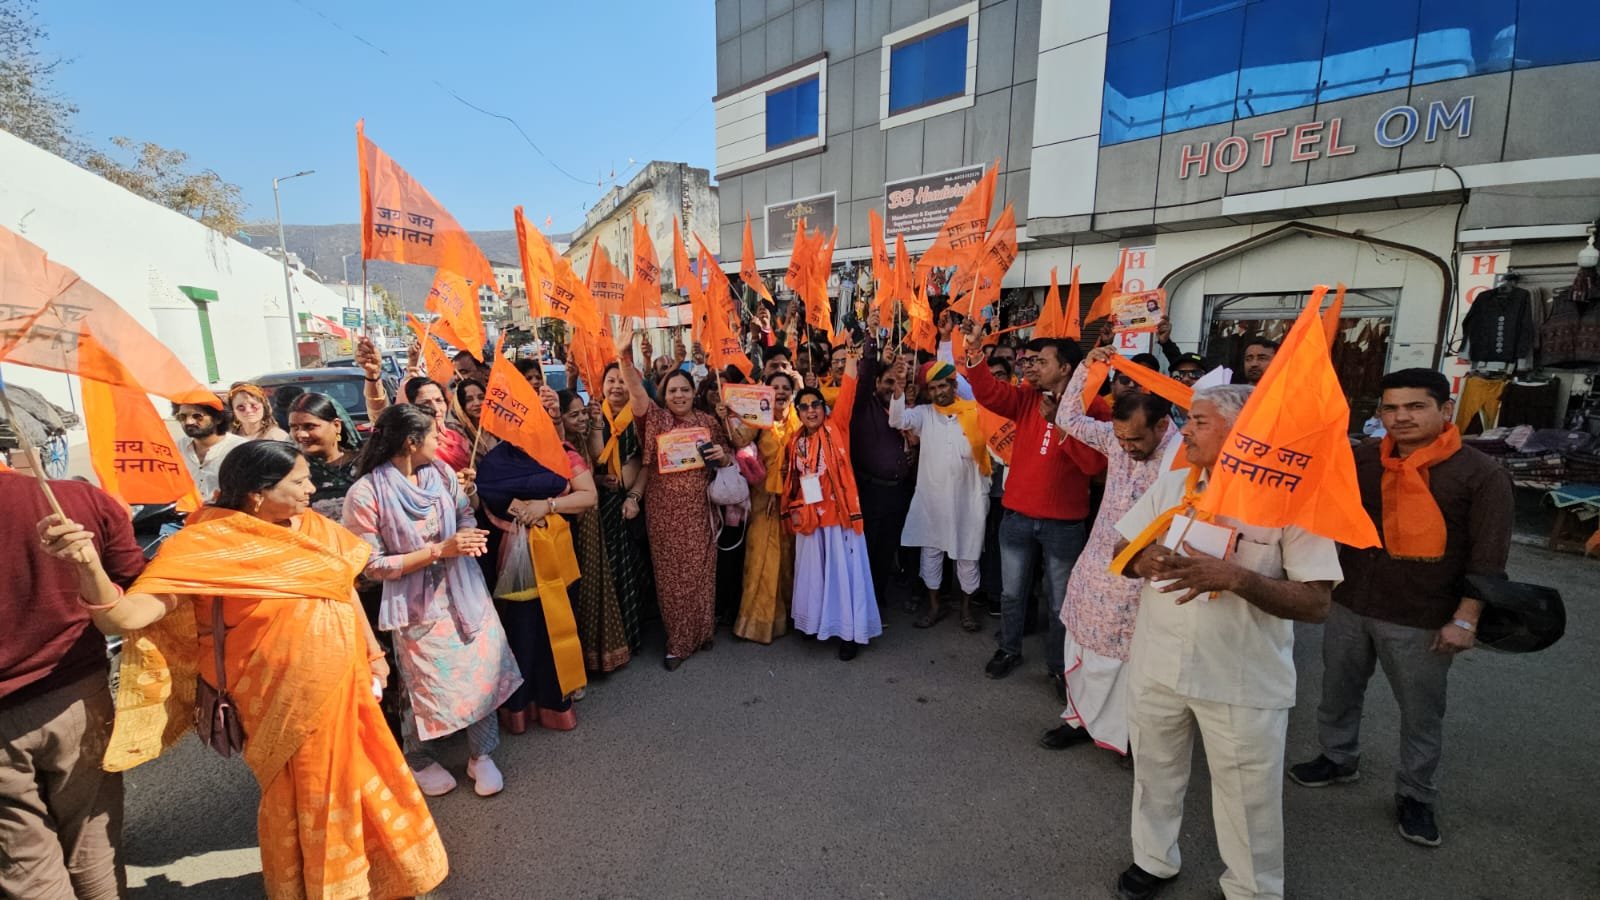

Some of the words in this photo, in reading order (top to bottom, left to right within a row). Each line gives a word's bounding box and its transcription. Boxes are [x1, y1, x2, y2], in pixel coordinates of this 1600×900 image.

[1179, 117, 1356, 179] HOTEL
[1374, 96, 1475, 149] OM
[376, 207, 400, 220] जय
[407, 212, 434, 229] जय
[374, 223, 434, 247] सनातन
[555, 286, 575, 302] जय
[592, 290, 624, 301] सनातन
[512, 400, 529, 416] जय
[1235, 432, 1272, 459] जय
[1278, 447, 1313, 470] जय
[1221, 451, 1303, 493] सनातन
